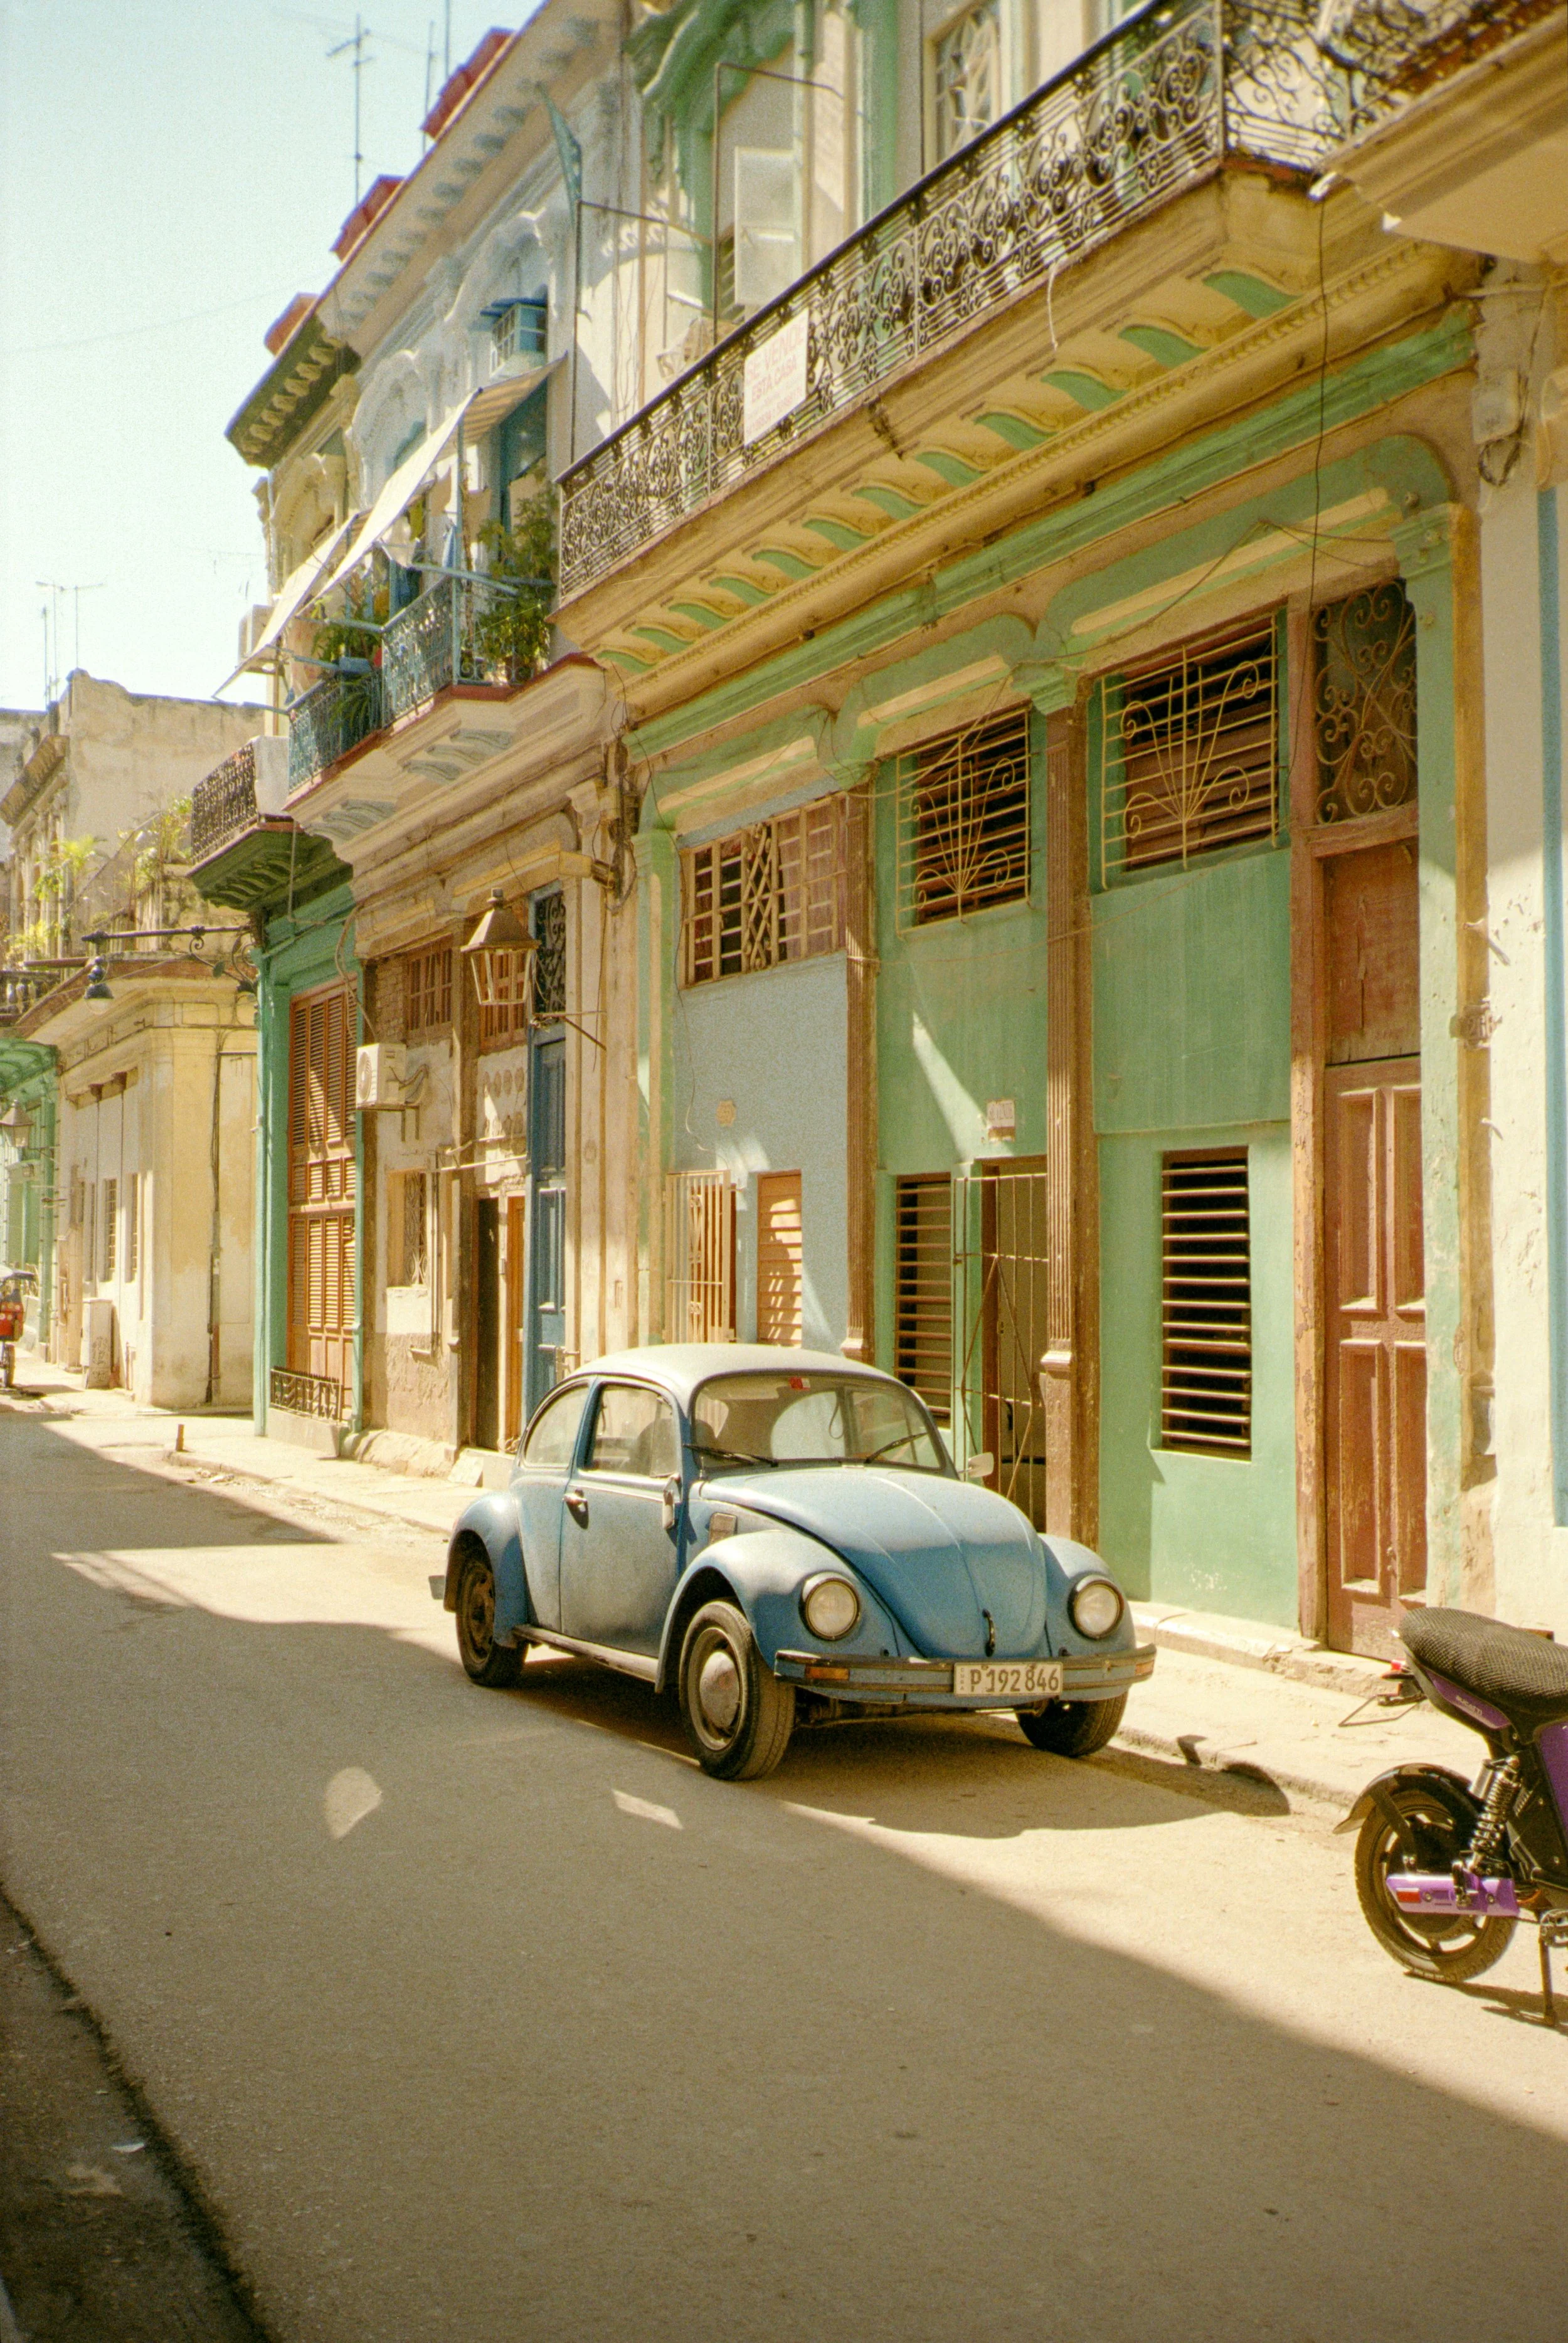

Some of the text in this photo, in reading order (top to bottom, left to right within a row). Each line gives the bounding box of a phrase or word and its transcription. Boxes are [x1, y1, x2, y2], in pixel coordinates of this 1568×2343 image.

[745, 316, 804, 387] SE VENDE
[751, 371, 773, 405] ESTA
[775, 351, 797, 387] CASA
